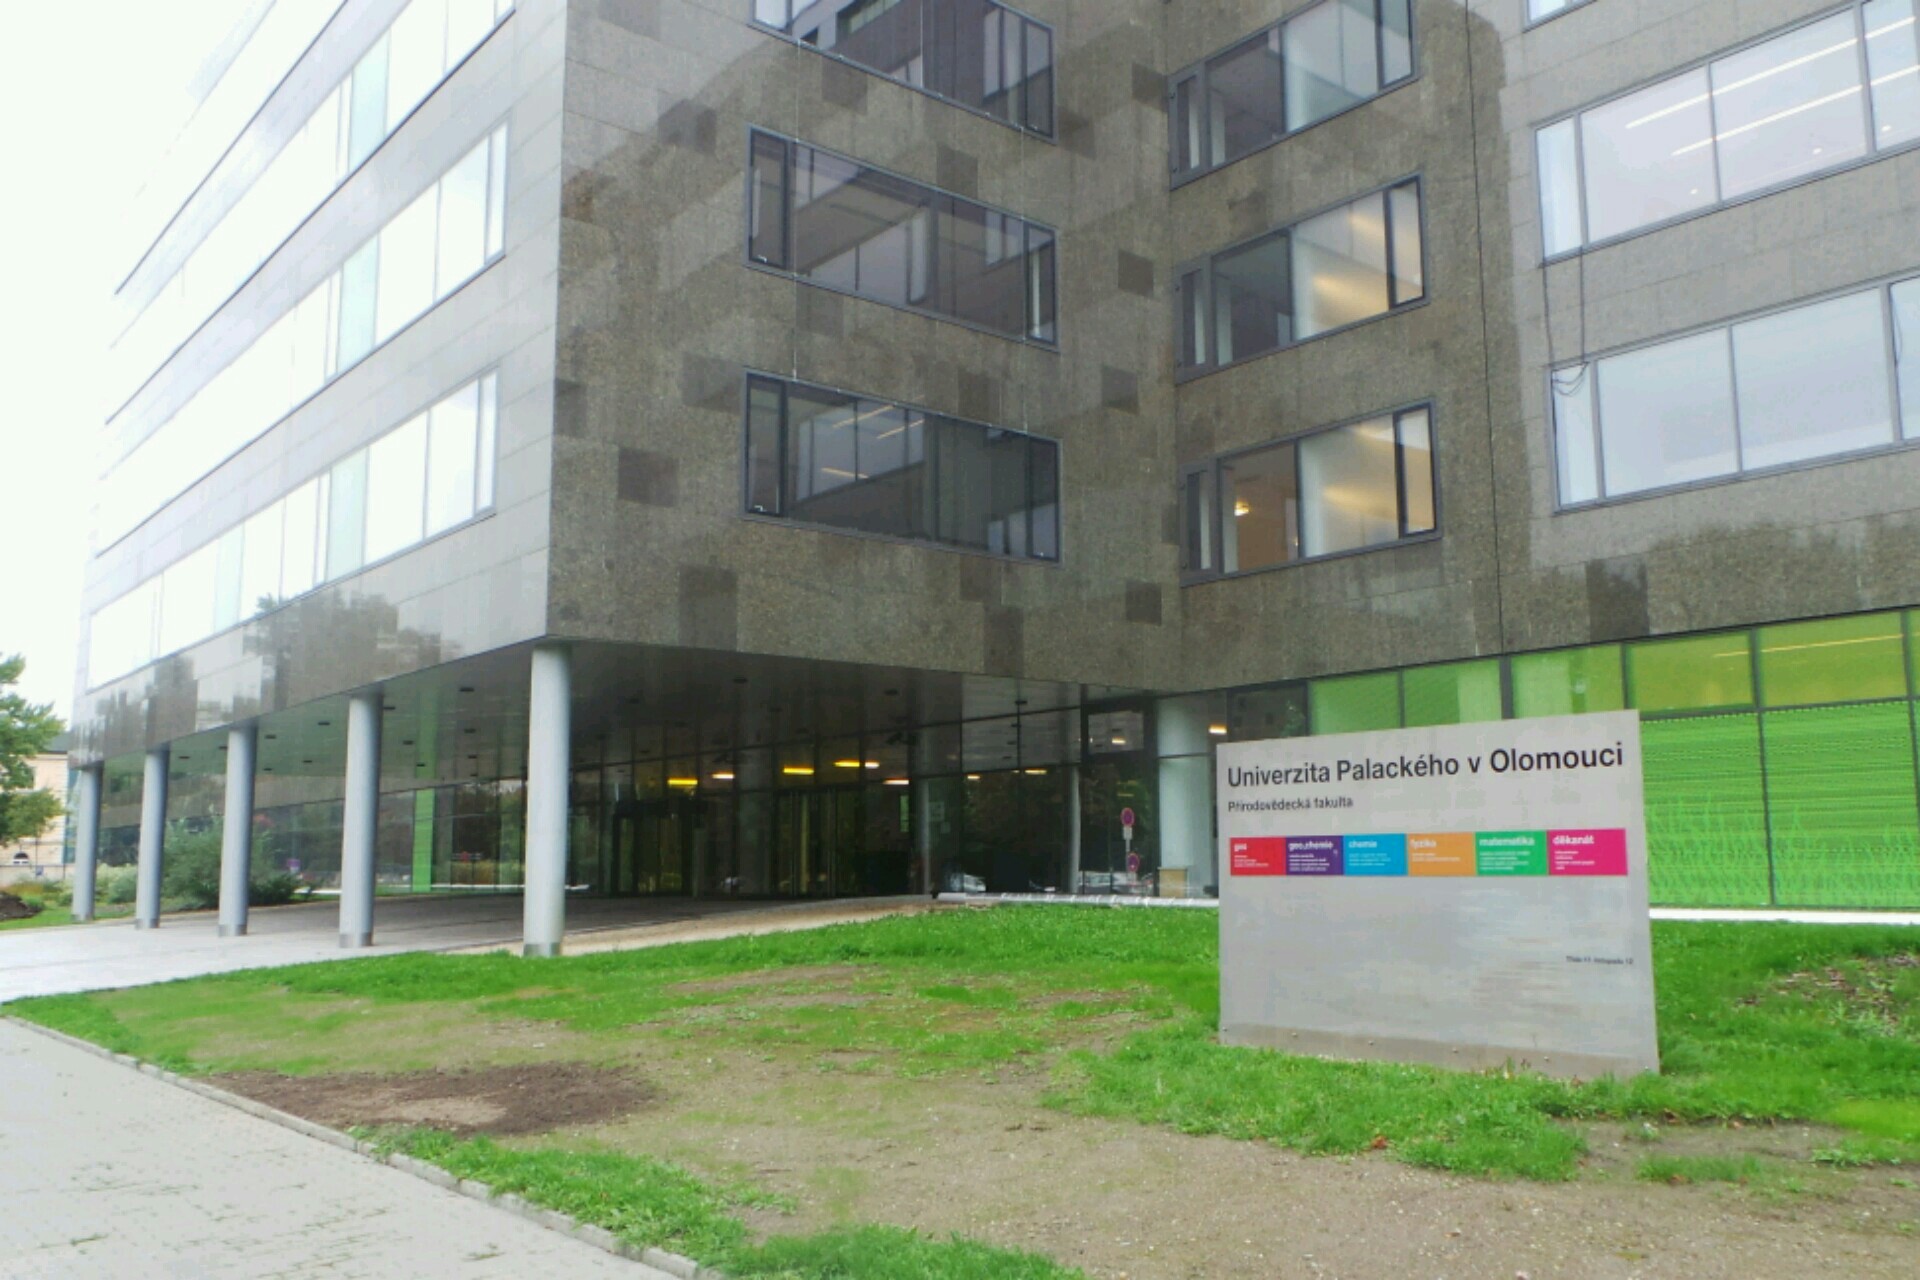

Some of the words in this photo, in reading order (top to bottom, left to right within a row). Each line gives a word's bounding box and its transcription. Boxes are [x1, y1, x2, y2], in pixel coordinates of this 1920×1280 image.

[1228, 762, 1330, 788] Univerzita
[1336, 754, 1459, 781] Palackého
[1467, 756, 1481, 773] v
[1490, 741, 1623, 773] Olomouci
[1314, 797, 1353, 809] fakulta
[1479, 836, 1535, 847] matematika
[1552, 834, 1595, 845] děkanát
